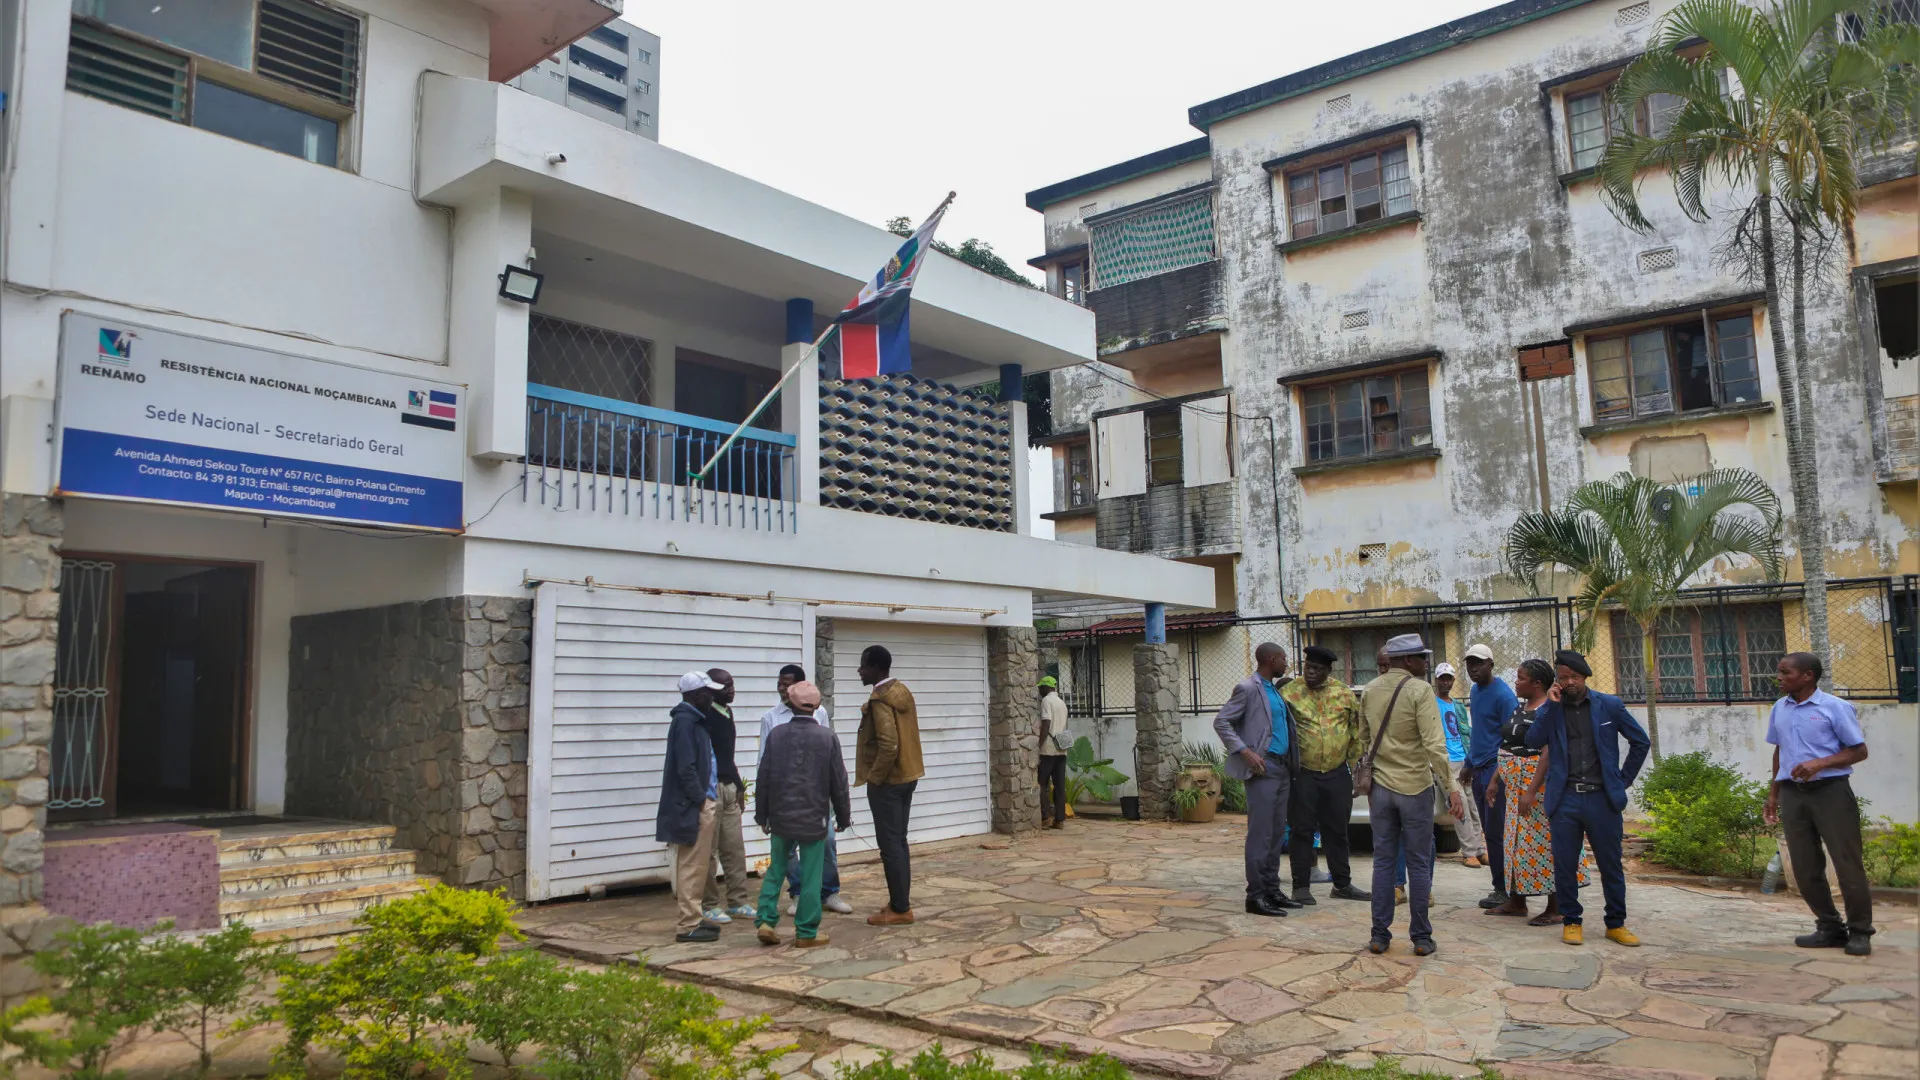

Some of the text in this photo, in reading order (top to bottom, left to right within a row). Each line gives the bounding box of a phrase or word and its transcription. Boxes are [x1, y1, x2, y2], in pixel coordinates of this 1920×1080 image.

[80, 363, 147, 384] RENAMO
[160, 358, 397, 409] RESISTÊNCIA NACIONAL MOÇAMBICANA
[145, 404, 187, 424] Sede
[191, 411, 260, 435] Nacional
[275, 425, 365, 450] Secretariado
[368, 439, 404, 456] Geral
[114, 447, 161, 462] Avenida
[163, 454, 203, 468] Ahmed
[204, 459, 238, 472] Sekou
[240, 463, 268, 476] Touré
[284, 470, 302, 480] 657
[326, 474, 355, 486] Bairro
[356, 478, 387, 491] Polana
[388, 482, 426, 496] Cimento
[138, 464, 193, 480] Contacto:
[195, 471, 209, 482] 84
[211, 473, 225, 484] 39
[226, 475, 238, 486] 81
[260, 479, 291, 491] Email:
[292, 484, 410, 506] secgeral@renamo.org.mz
[224, 488, 264, 501] Maputo
[272, 494, 336, 509] Moçambique
